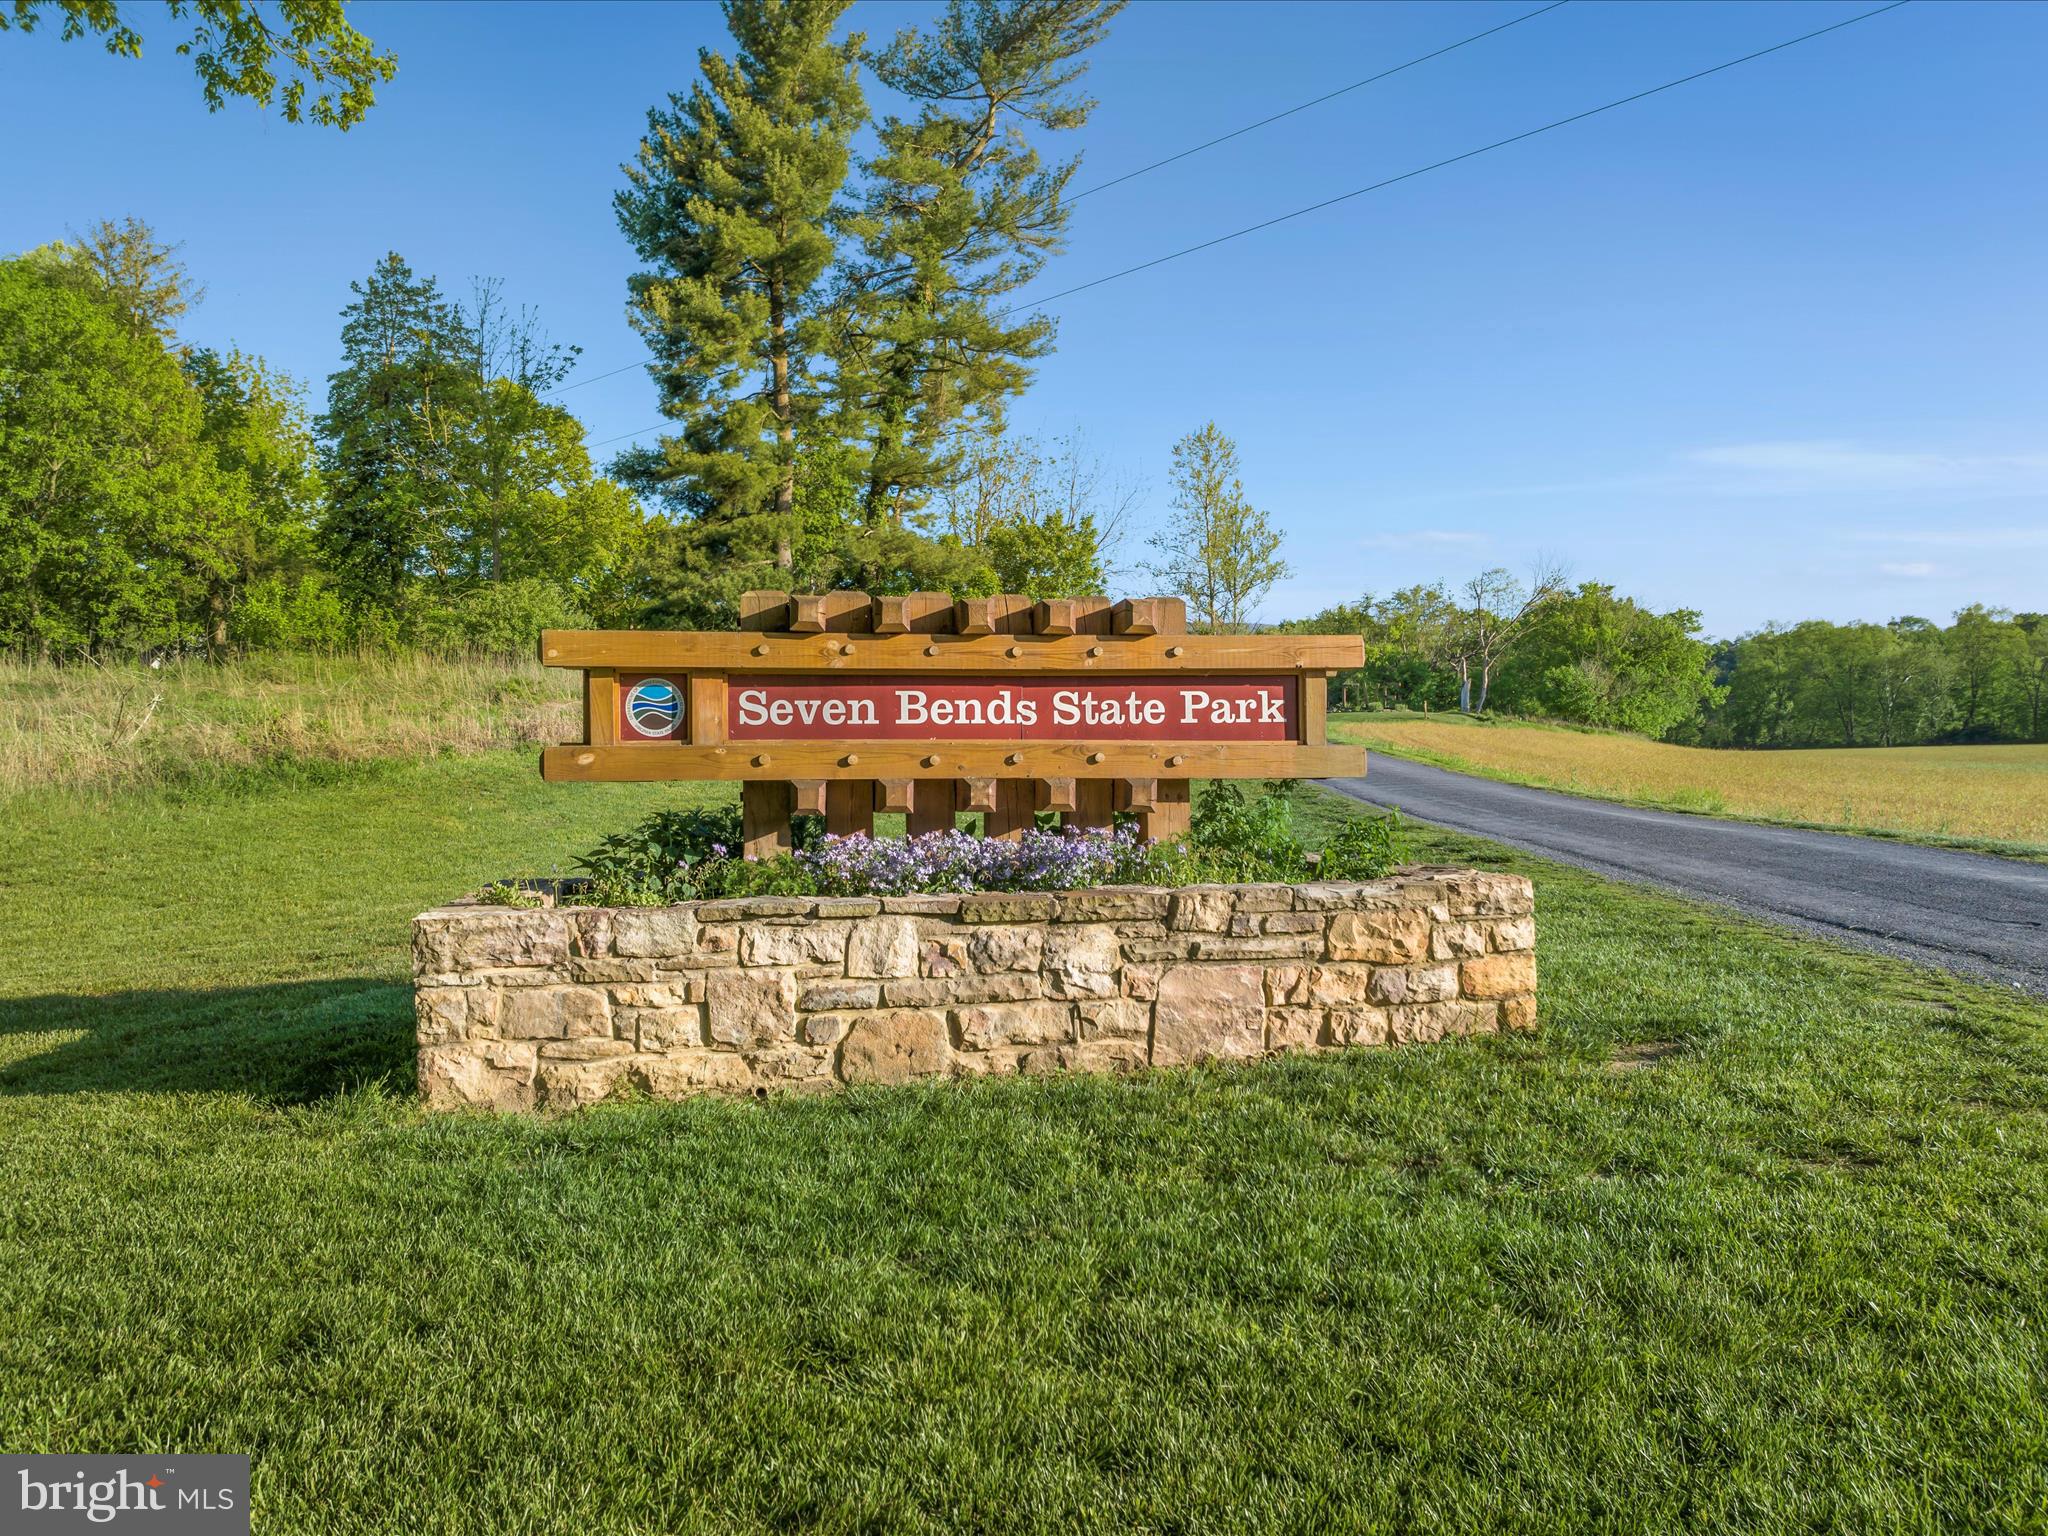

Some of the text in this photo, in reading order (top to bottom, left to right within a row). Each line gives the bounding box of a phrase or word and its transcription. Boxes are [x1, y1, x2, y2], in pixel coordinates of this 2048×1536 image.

[737, 689, 1287, 726] Seven Bends State Park
